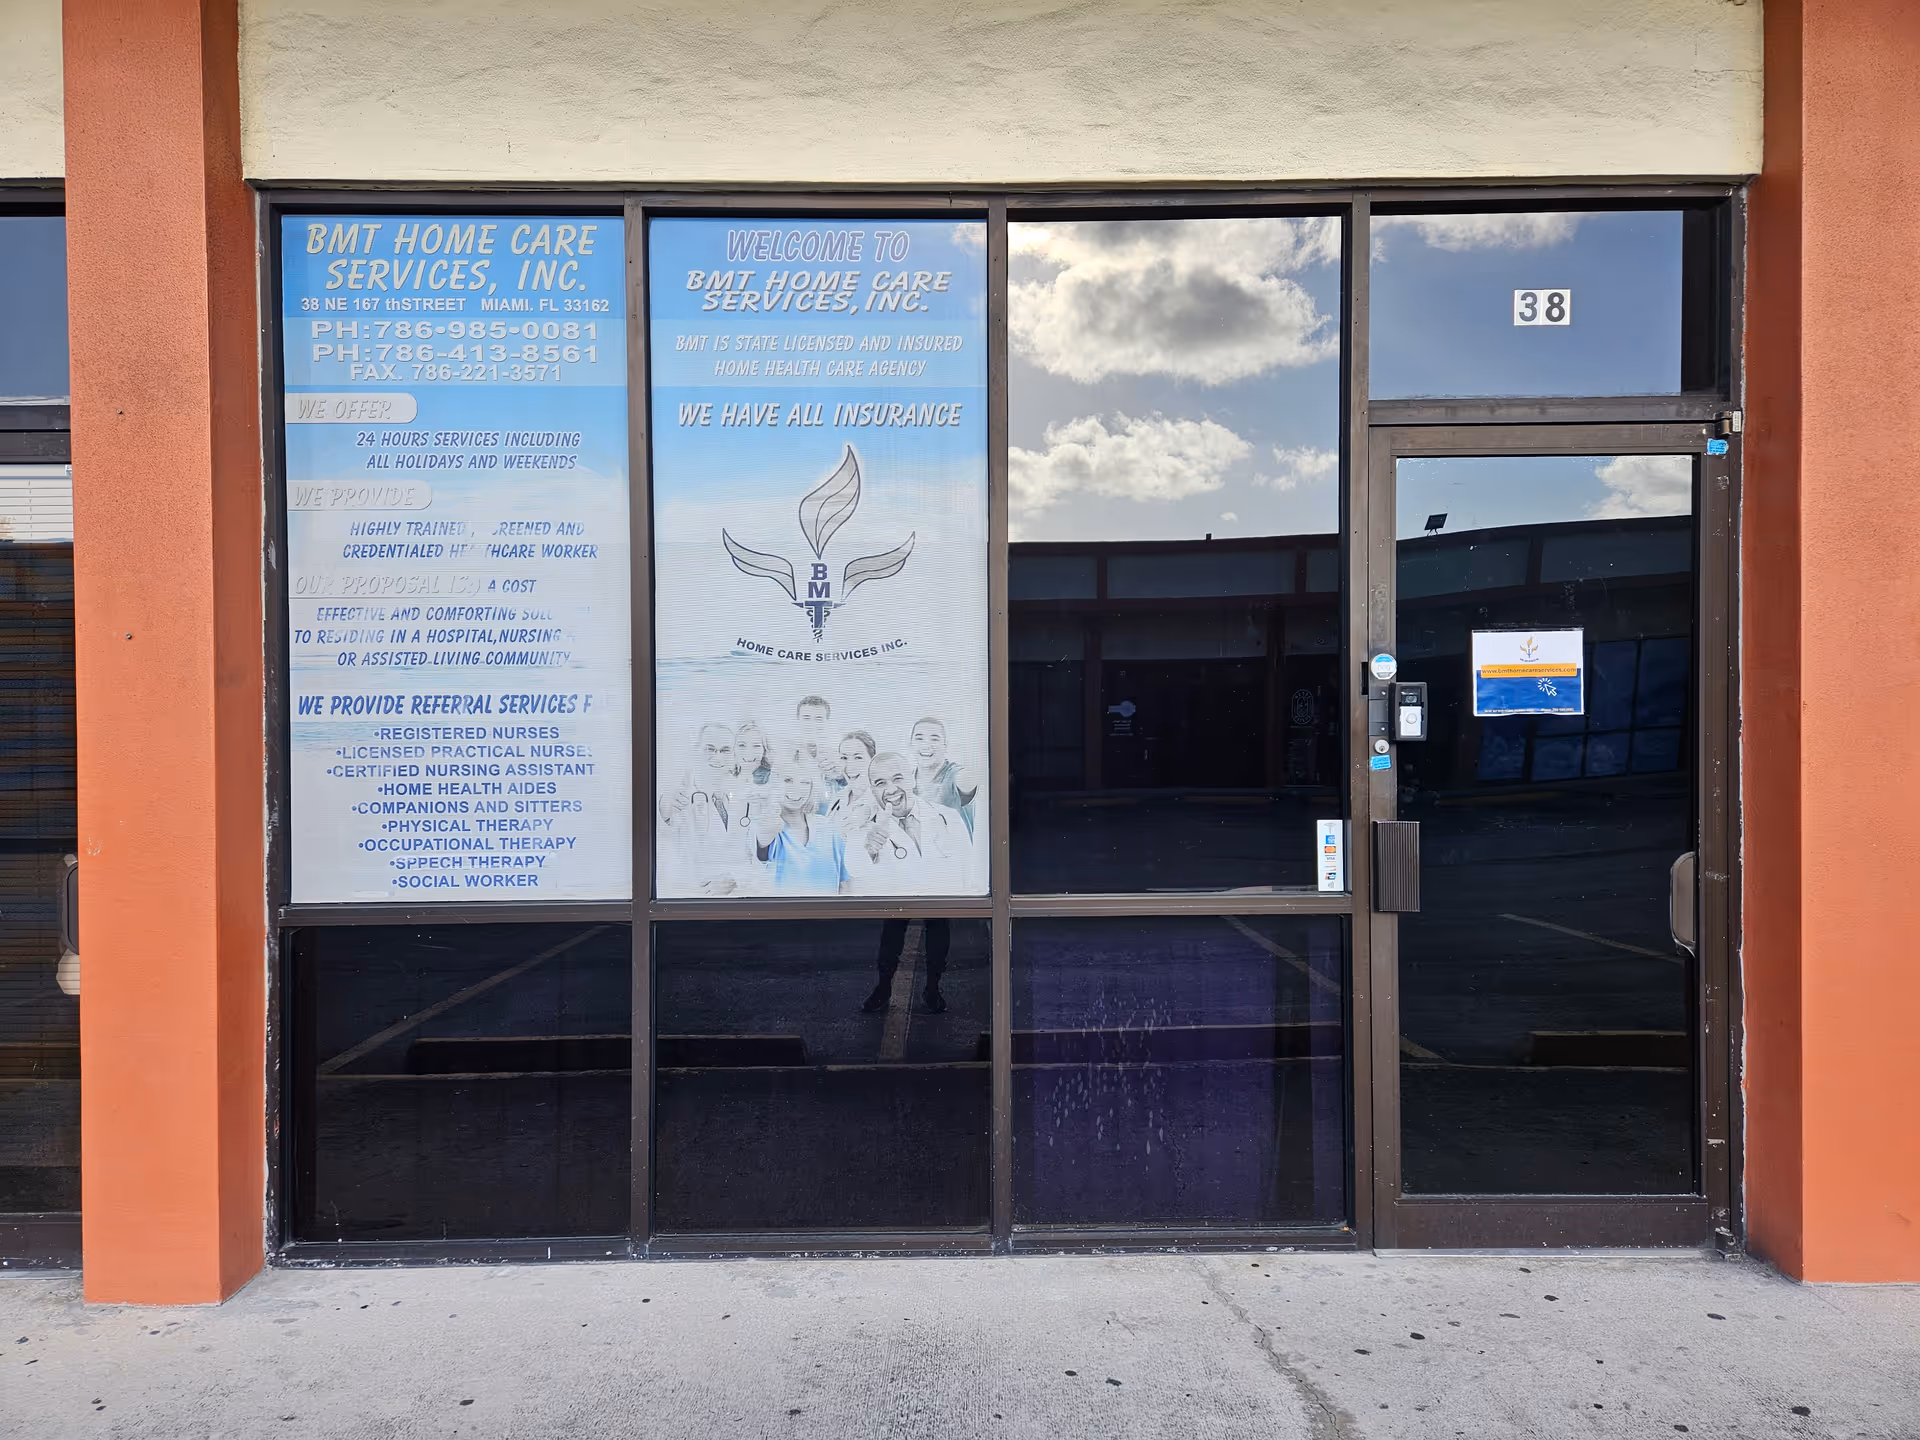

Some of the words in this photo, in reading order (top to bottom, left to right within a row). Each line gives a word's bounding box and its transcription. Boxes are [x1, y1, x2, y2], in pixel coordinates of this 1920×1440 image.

[306, 223, 382, 255] BMT
[394, 224, 498, 256] HOME
[511, 225, 598, 256] CARE
[727, 230, 864, 262] WELCOME
[874, 231, 910, 263] TO
[326, 259, 497, 296] SERVICES,
[517, 259, 587, 291] INC.
[686, 270, 756, 292] BMT
[766, 271, 861, 292] HOME
[872, 271, 952, 293] CARE
[301, 299, 320, 311] 38
[325, 299, 348, 311] NE
[353, 299, 380, 311] 167
[539, 300, 559, 312] FL
[564, 299, 609, 313] 33162
[1518, 292, 1566, 322] 38
[676, 336, 709, 351] BMT
[713, 336, 729, 351] IS
[736, 335, 778, 351] STATE
[784, 335, 854, 351] LICENSED
[859, 336, 891, 351] AND
[897, 336, 963, 352] INSURED
[350, 365, 402, 381] FAX.
[412, 364, 561, 382] 786-221-3571
[714, 360, 760, 376] HOME
[765, 360, 821, 376] HEALTH
[826, 361, 864, 376] CARE
[869, 360, 927, 376] AGENCY
[297, 399, 326, 419] WE
[334, 399, 392, 420] OFFER
[678, 403, 713, 427] WE
[721, 403, 779, 427] HAVE
[786, 403, 824, 427] ALL
[833, 403, 962, 427] INSURANCE
[356, 432, 376, 447] 24
[381, 432, 429, 447] HOURS
[434, 432, 500, 447] SERVICES
[504, 432, 581, 447] INCLUDING
[366, 455, 390, 469] ALL
[395, 454, 464, 470] HOLIDAYS
[468, 455, 498, 470] AND
[503, 455, 577, 470] WEEKENDS
[295, 486, 324, 506] WE
[329, 486, 415, 507] PROVIDE
[350, 522, 401, 536] HIGHLY
[556, 522, 585, 536] AND
[343, 544, 443, 559] CREDENTIALED
[541, 544, 598, 558] WORKER
[342, 574, 441, 594] PROPOSAL
[487, 579, 496, 592] A
[502, 579, 537, 593] COST
[317, 607, 385, 622] EFFECTIVE
[391, 608, 420, 621] AND
[426, 607, 517, 621] COMFORTING
[295, 630, 311, 643] TO
[317, 630, 384, 643] RESIDING
[390, 629, 406, 643] IN
[411, 629, 421, 643] A
[736, 638, 774, 655] HOME
[777, 650, 812, 661] CARE
[815, 647, 878, 662] SERVICES
[881, 639, 908, 653] INC.
[338, 652, 356, 666] OR
[361, 652, 427, 666] ASSISTED
[434, 652, 480, 666] LIVING
[486, 652, 570, 665] COMMUNITY
[299, 695, 324, 715] WE
[330, 695, 404, 716] PROVIDE
[411, 695, 492, 715] REFERRAL
[499, 694, 578, 715] SERVICES
[380, 728, 486, 740] REGISTERED
[492, 727, 559, 739] NURSES
[343, 747, 425, 759] LICENSED
[431, 746, 524, 758] PRACTICAL
[333, 765, 419, 777] CERTIFIED
[425, 765, 500, 776] NURSING
[505, 764, 596, 776] ASSISTANT
[384, 784, 432, 795] HOME
[438, 783, 502, 795] HEALTH
[507, 782, 557, 794] AIDES
[358, 802, 468, 814] COMPANIONS
[474, 801, 508, 813] AND
[514, 801, 583, 812] SITTERS
[388, 820, 470, 832] PHYSICAL
[476, 819, 553, 831] THERAPY
[365, 839, 494, 851] OCCUPATIONAL
[500, 838, 576, 850] THERAPY
[468, 856, 546, 868] THERAPY
[399, 876, 459, 888] SOCIAL
[465, 875, 538, 887] WORKER
